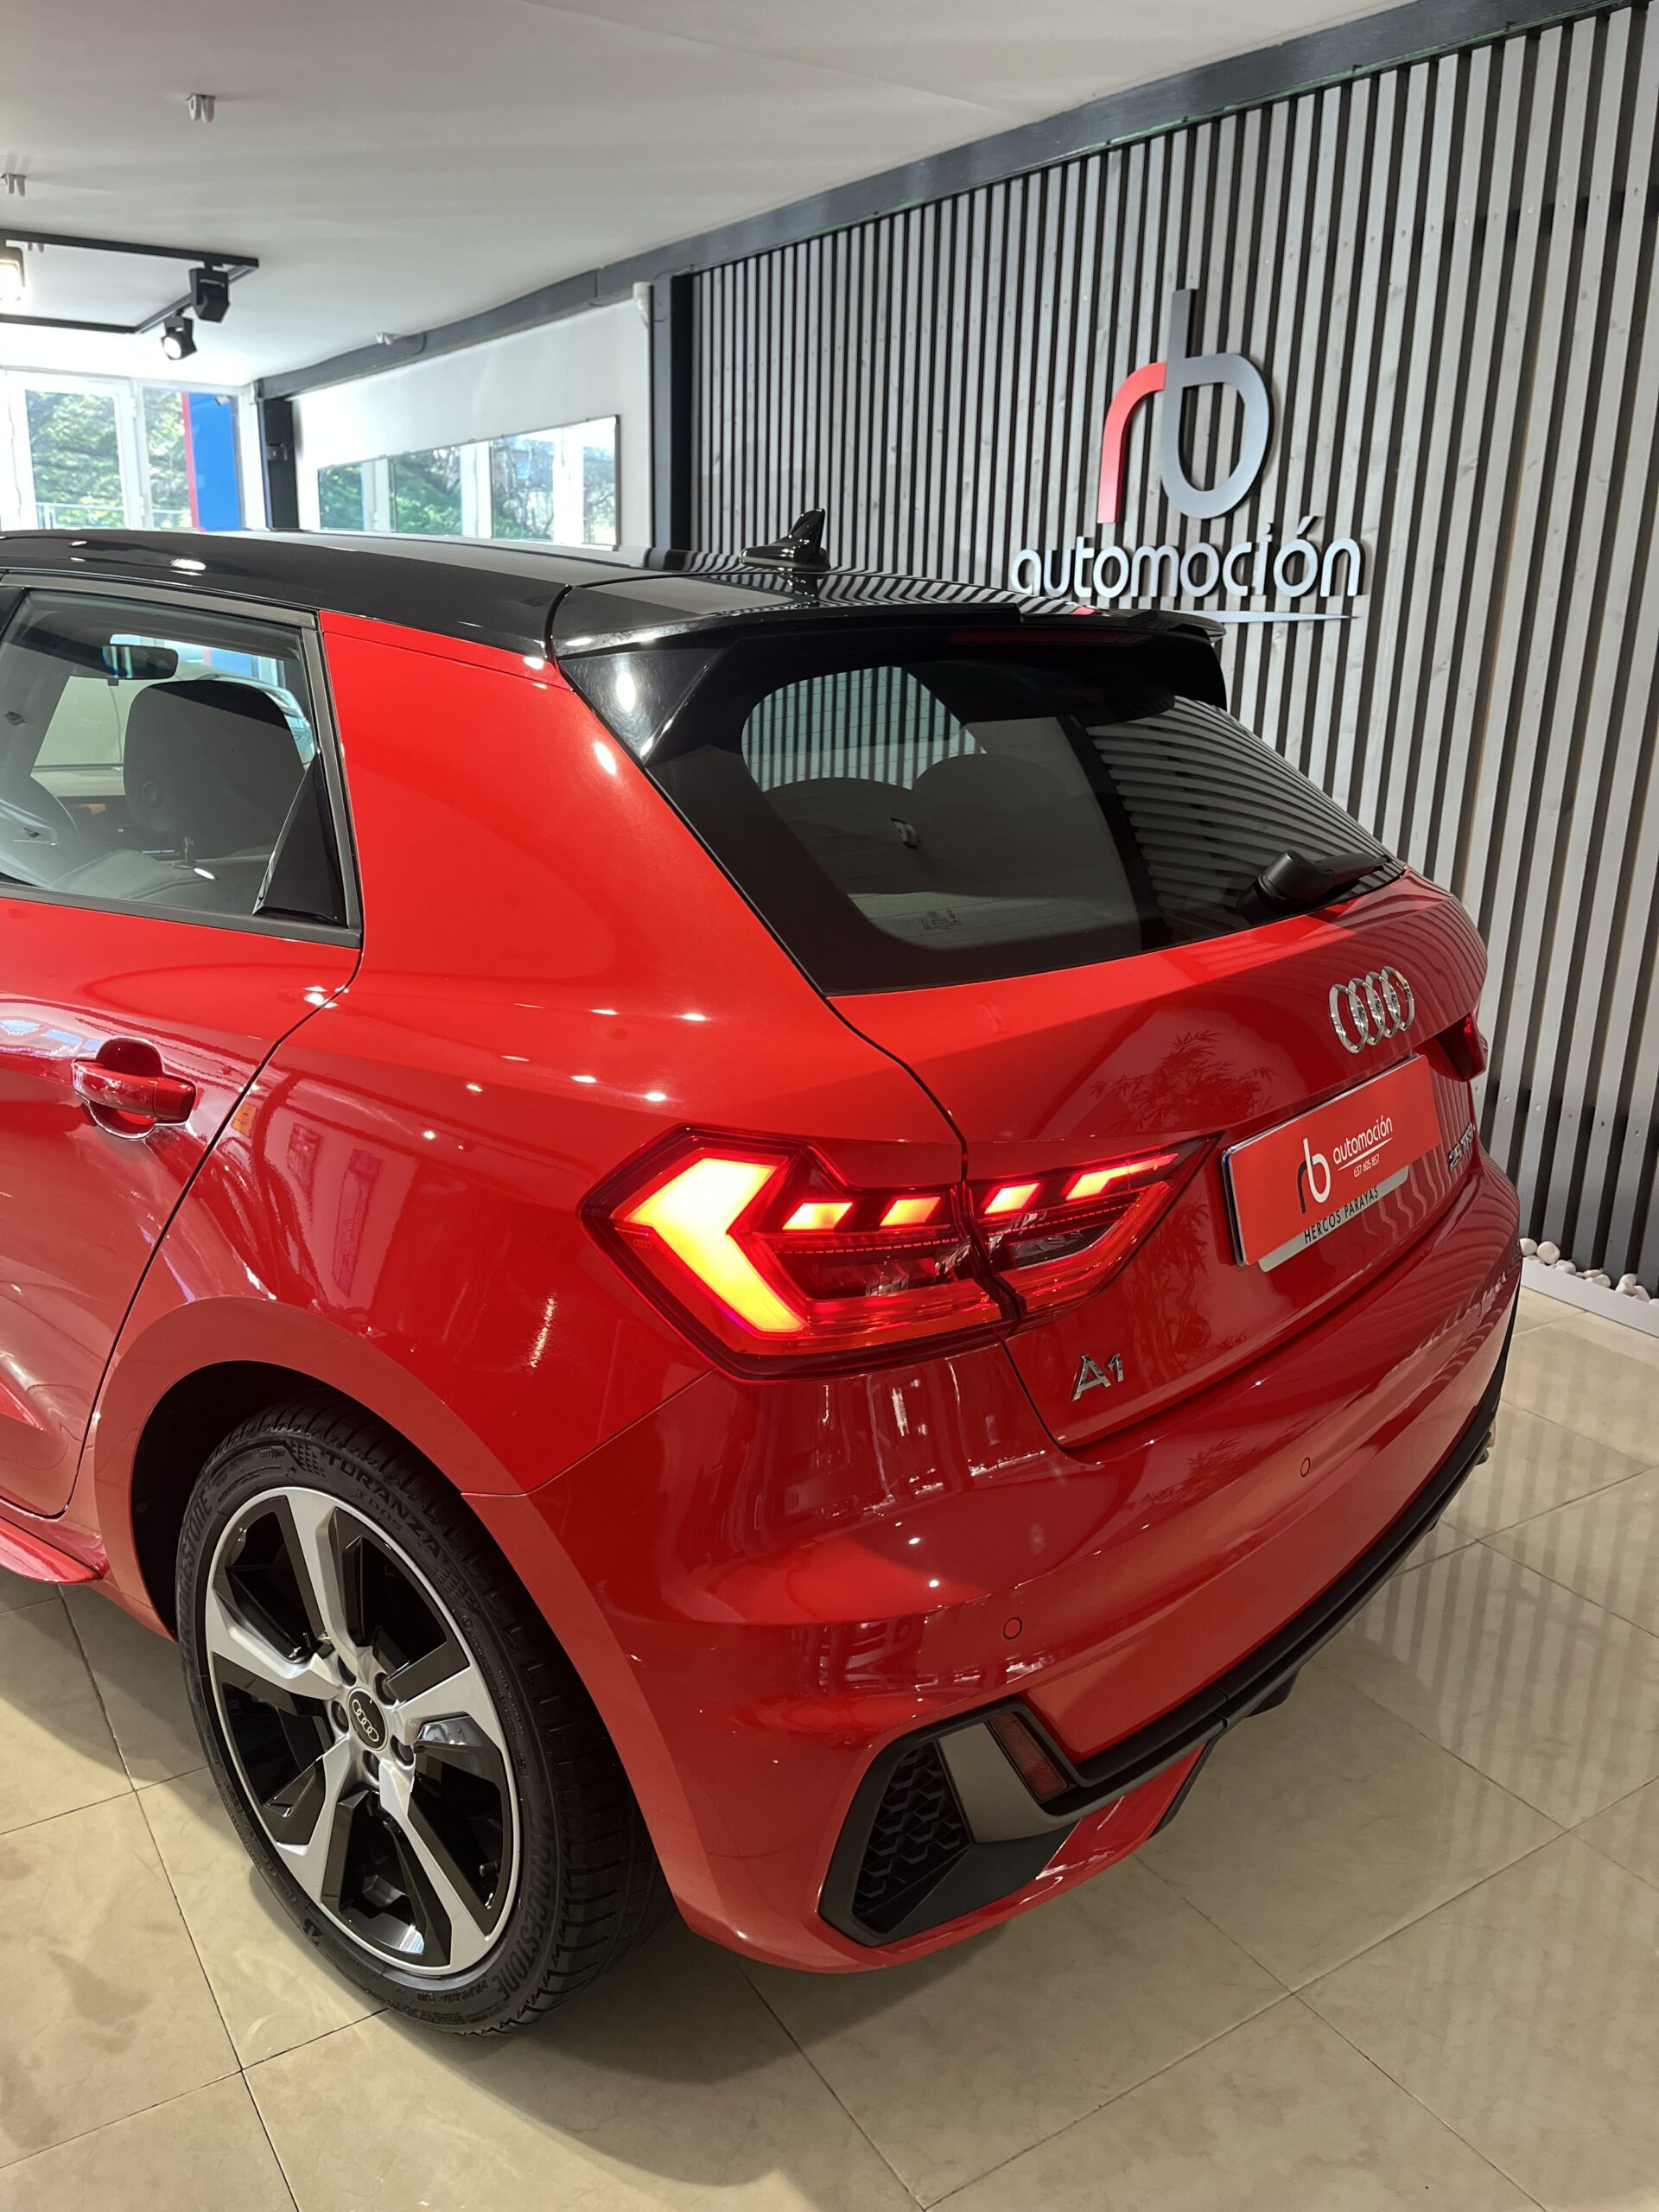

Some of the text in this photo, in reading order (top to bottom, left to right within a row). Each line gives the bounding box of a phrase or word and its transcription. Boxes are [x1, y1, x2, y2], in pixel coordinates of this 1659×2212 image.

[1010, 516, 1363, 598] automoción
[1332, 1114, 1393, 1165] automoción
[1303, 1185, 1379, 1244] HERCOS PARAYAS
[1071, 1353, 1124, 1402] A1
[326, 1452, 441, 1559] TURANZA
[489, 1802, 553, 2004] BRIDGESTONE
